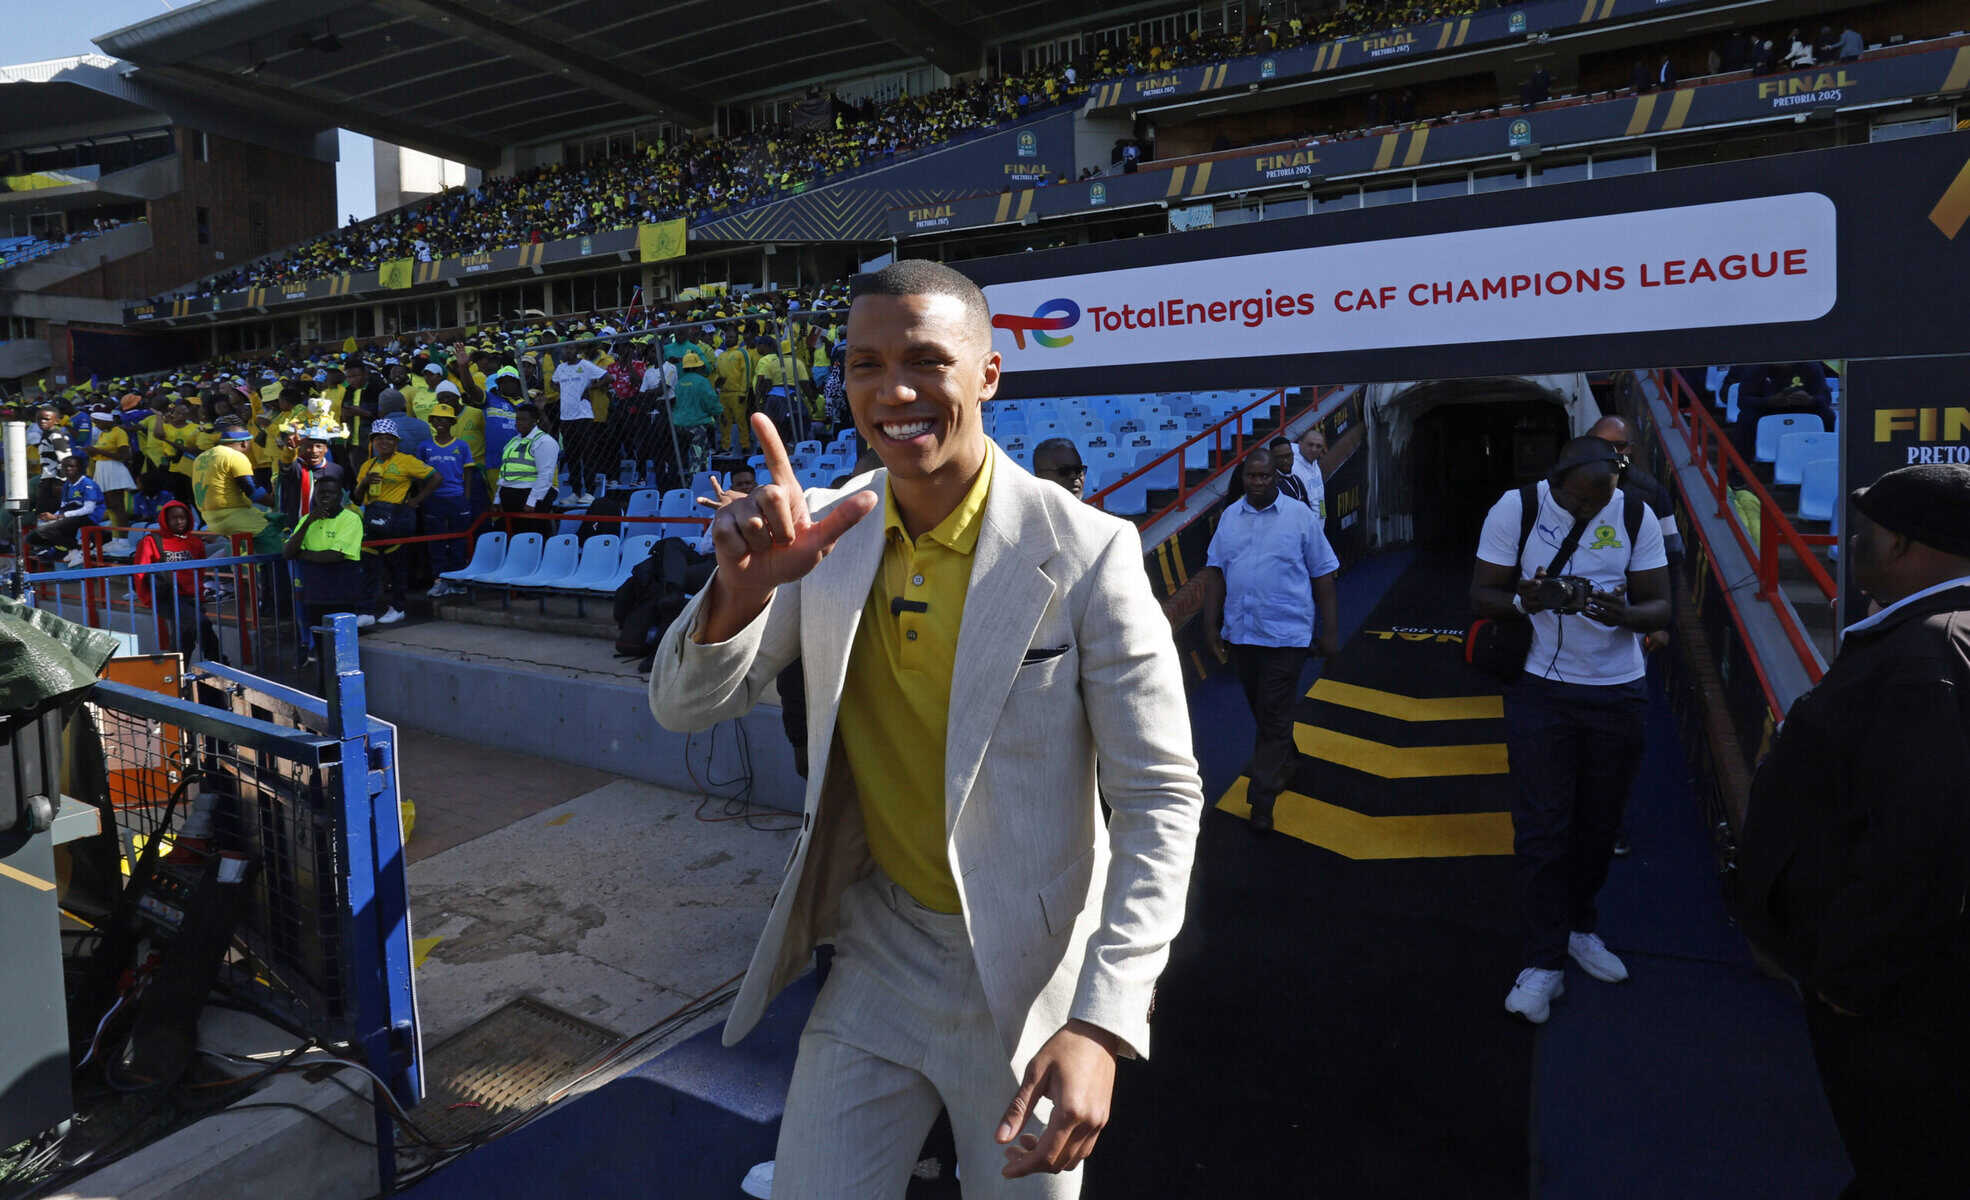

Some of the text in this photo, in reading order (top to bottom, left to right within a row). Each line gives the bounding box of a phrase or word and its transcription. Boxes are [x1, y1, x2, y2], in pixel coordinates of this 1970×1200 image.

[1362, 32, 1416, 52] FINAL
[1136, 75, 1182, 92] FINAL
[1758, 71, 1857, 99] FINAL
[1773, 89, 1842, 107] PRETORIA 2025
[1004, 164, 1053, 174] FINAL
[1256, 150, 1320, 171] FINAL
[1266, 165, 1312, 179] PRETORIA 2025
[908, 205, 957, 222] FINAL
[1087, 249, 1808, 332] TotalEnergies CAF CHAMPIONS LEAGUE
[1874, 407, 1970, 442] FIN
[1907, 446, 1970, 464] PRETO
[1363, 630, 1463, 643] NAL
